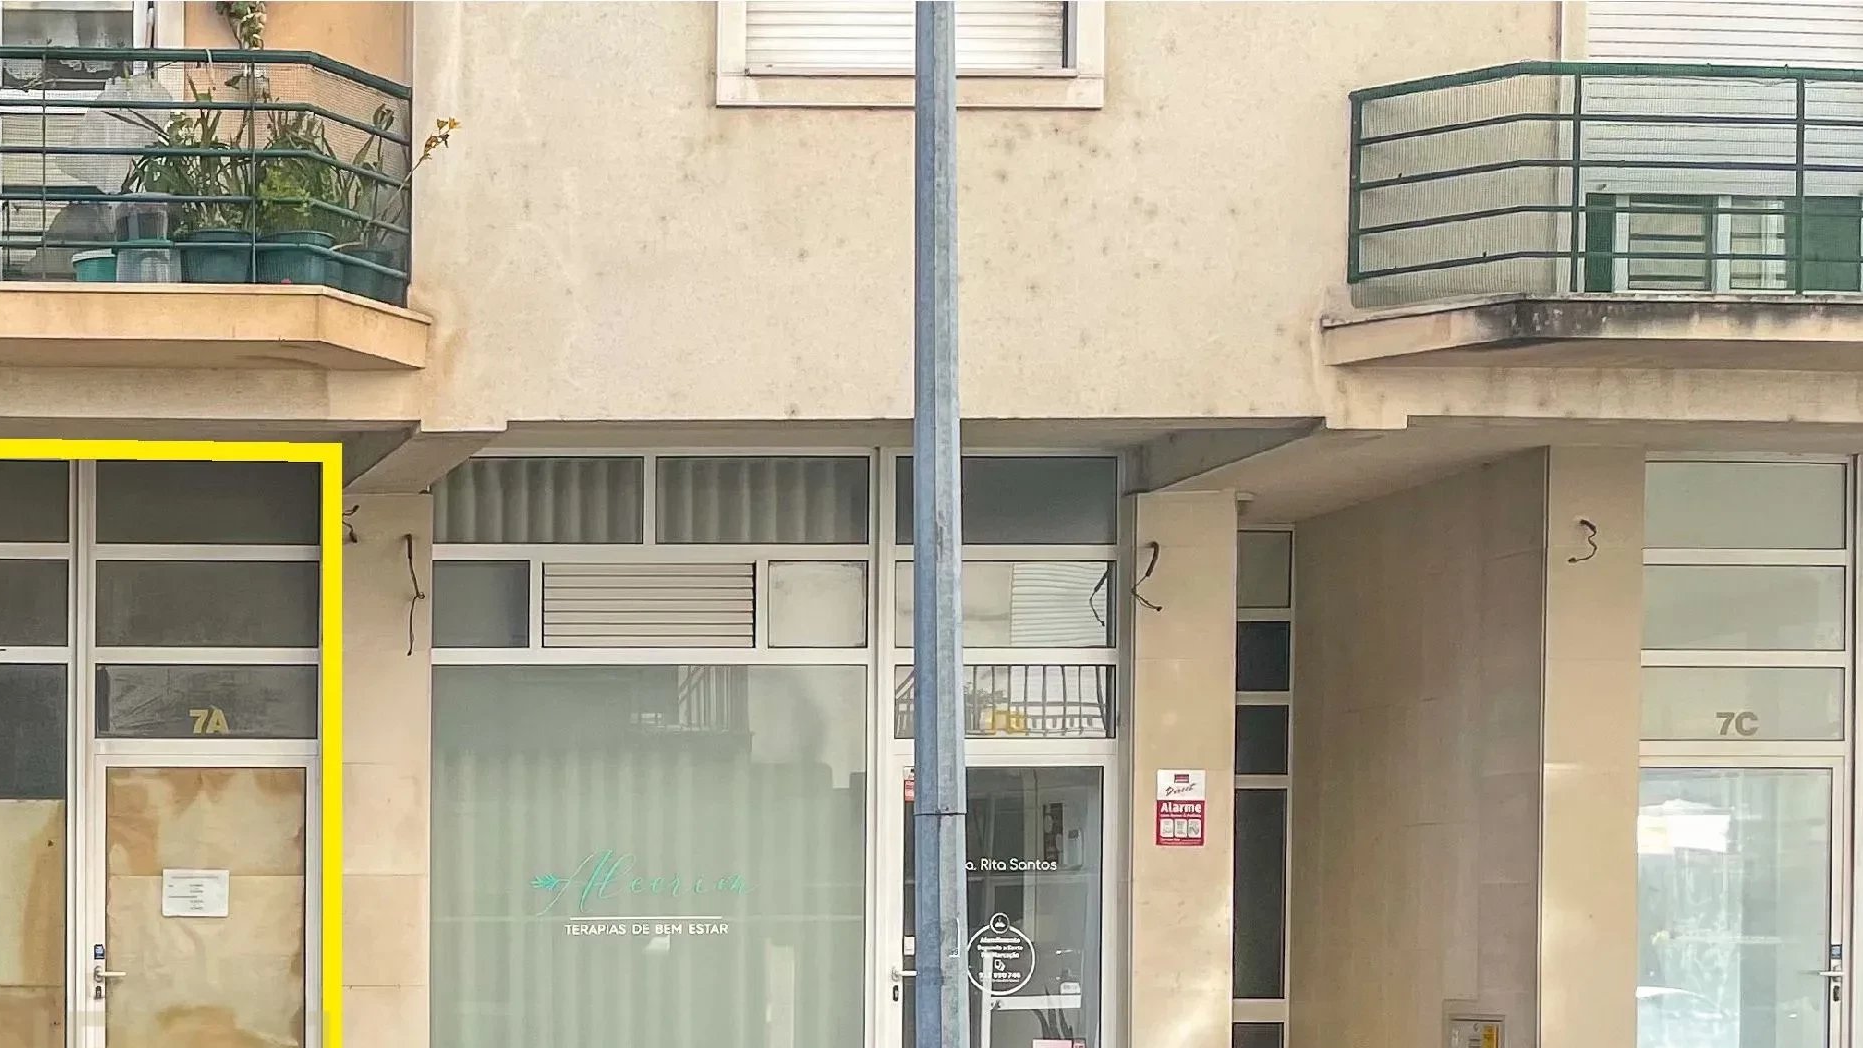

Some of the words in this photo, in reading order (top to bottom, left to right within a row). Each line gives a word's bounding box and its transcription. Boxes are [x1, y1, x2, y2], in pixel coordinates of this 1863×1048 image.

[189, 708, 230, 734] 7A
[1715, 711, 1759, 736] 7C
[1160, 802, 1202, 814] Alarme
[980, 858, 1007, 871] Rita
[1009, 858, 1057, 871] Santos
[565, 923, 627, 936] TERAPIAS
[632, 923, 650, 935] DE
[655, 923, 682, 935] BEM
[688, 923, 729, 935] ESTAR
